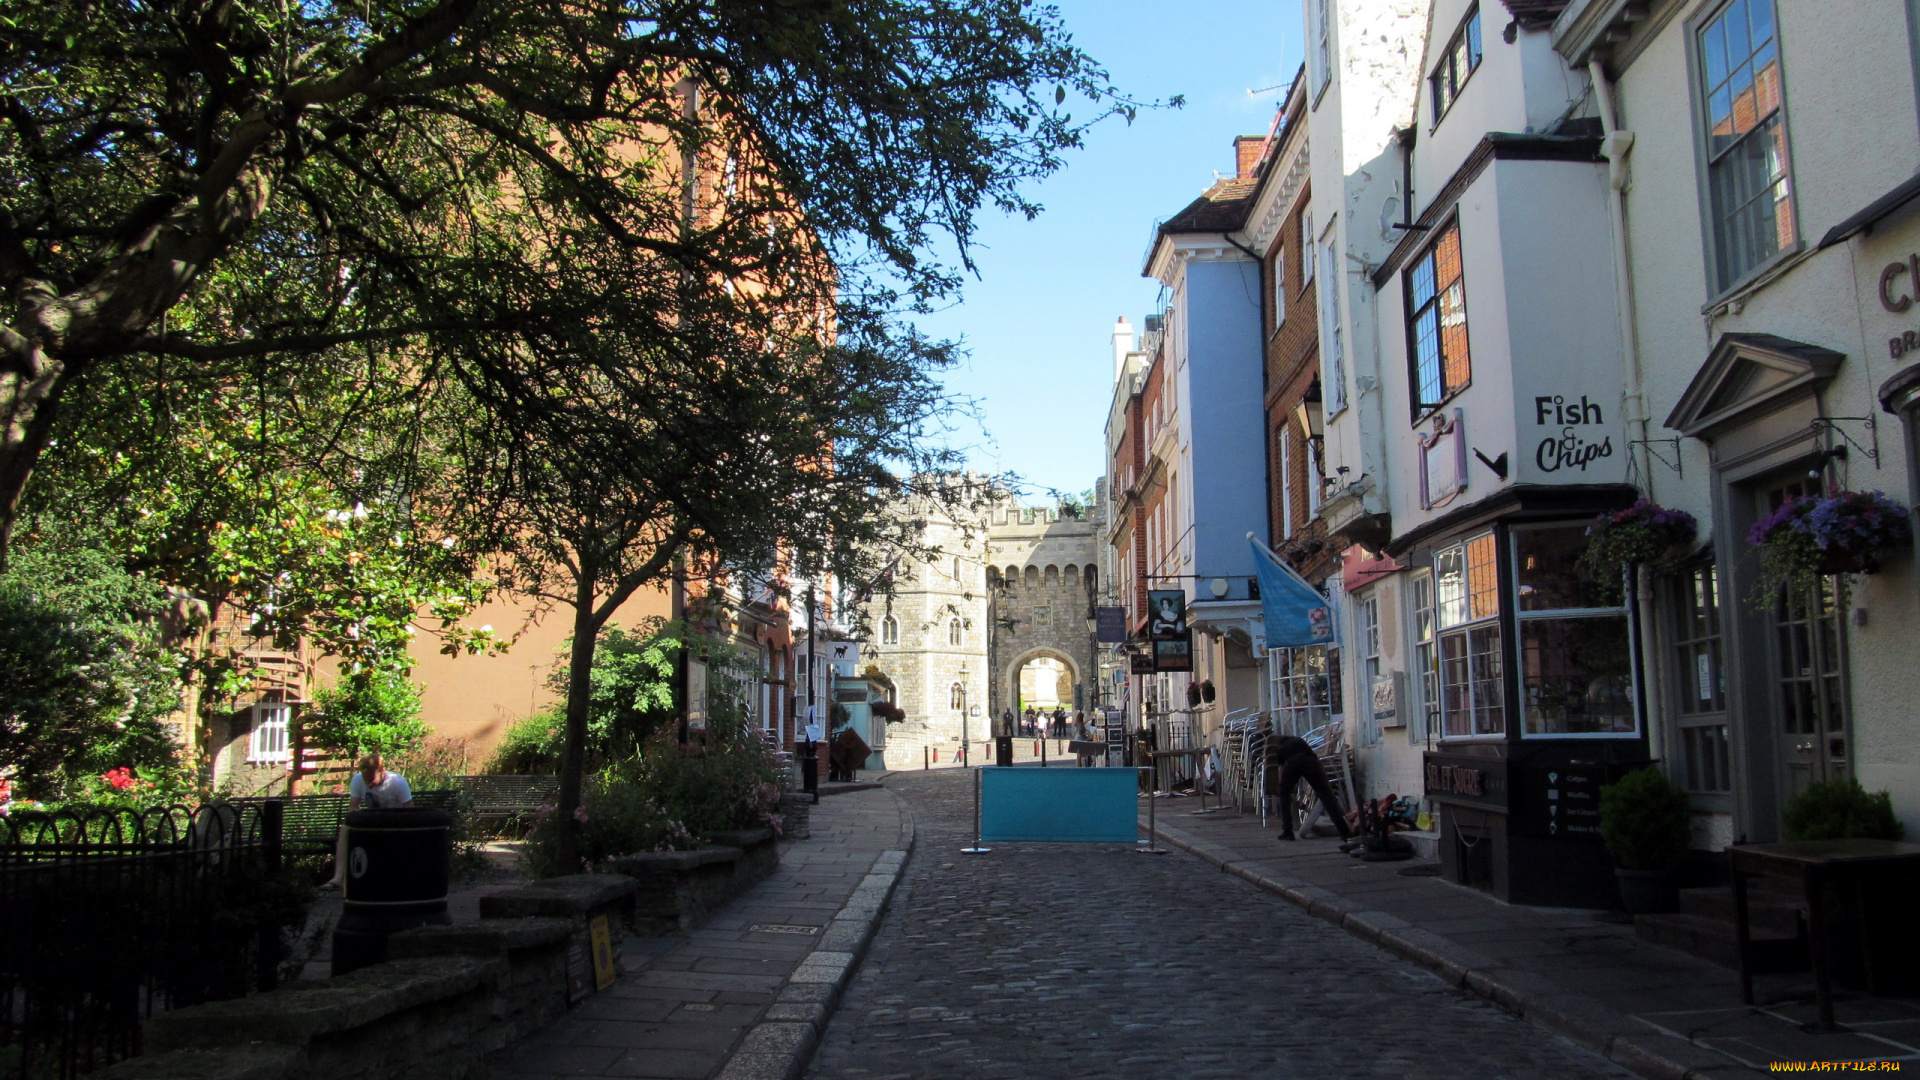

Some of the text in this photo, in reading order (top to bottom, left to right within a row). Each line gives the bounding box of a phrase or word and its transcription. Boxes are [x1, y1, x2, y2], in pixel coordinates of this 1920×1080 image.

[1888, 327, 1920, 359] BR
[1535, 395, 1603, 425] Fish
[1536, 436, 1612, 472] Chips
[1563, 427, 1576, 450] &
[1451, 764, 1481, 796] SUCRE
